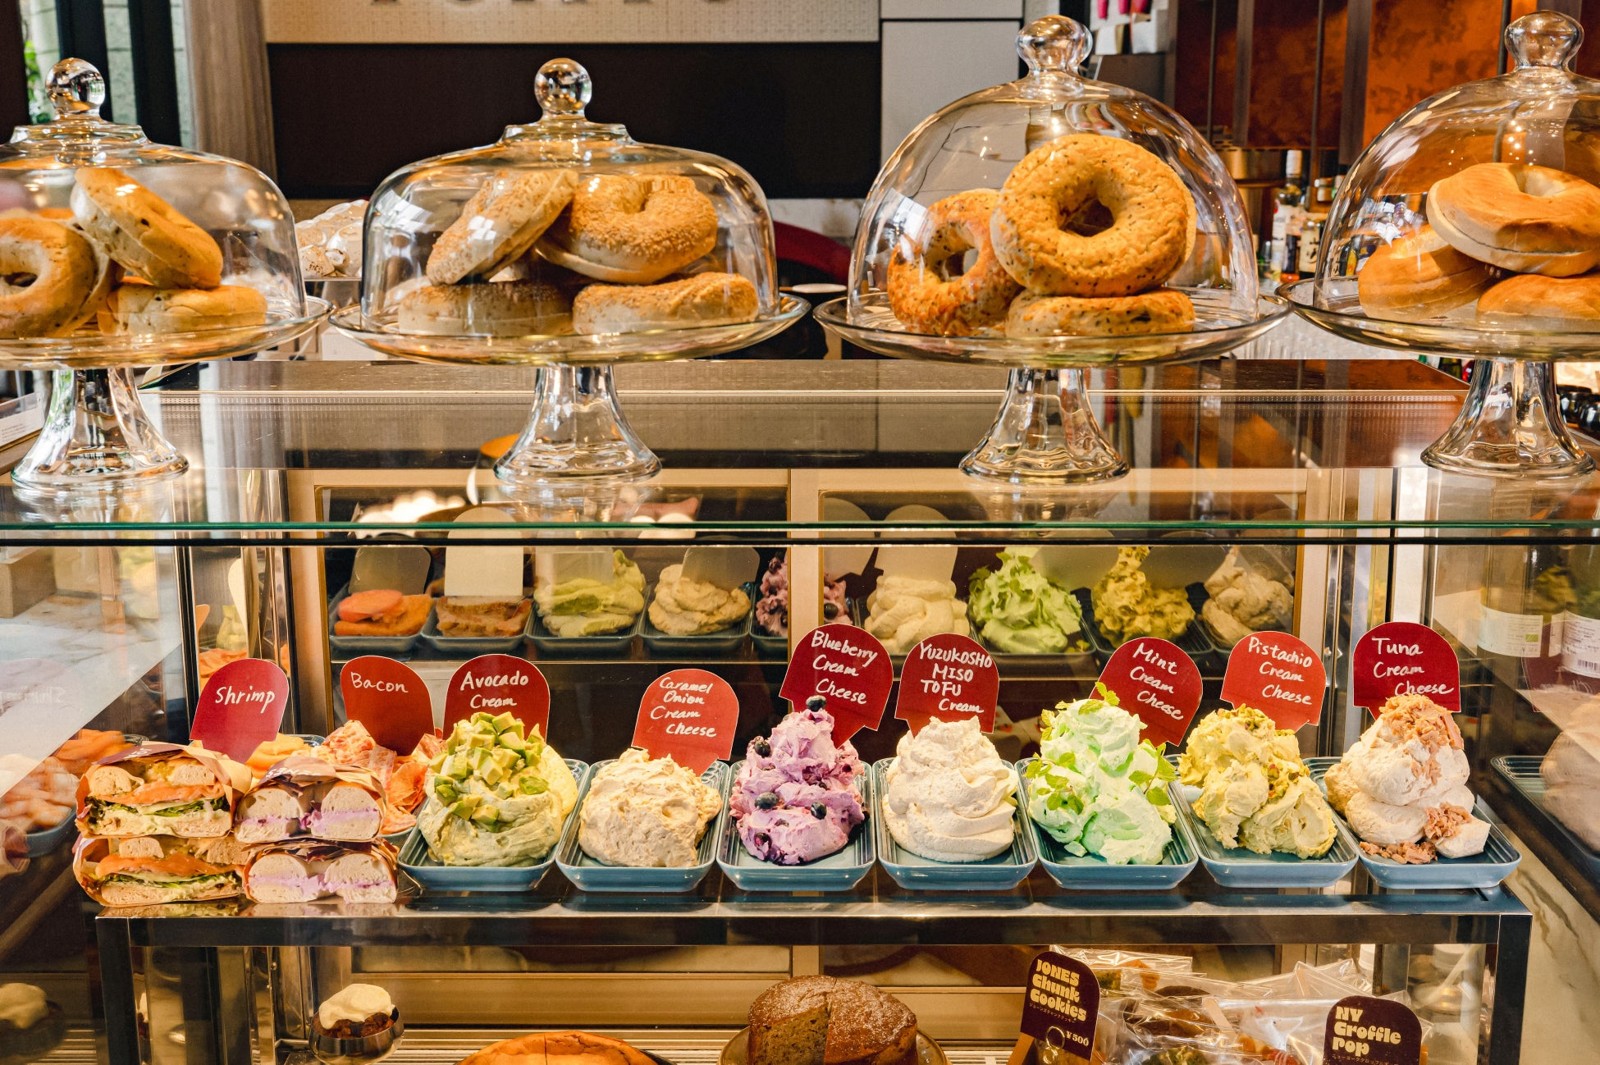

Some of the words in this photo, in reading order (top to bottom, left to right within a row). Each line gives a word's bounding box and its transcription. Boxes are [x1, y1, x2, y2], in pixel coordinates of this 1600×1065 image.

[811, 630, 878, 668] Blueberry
[1248, 636, 1313, 668] Pistachio
[1371, 637, 1424, 656] Tuna
[812, 654, 859, 677] Cream
[1132, 642, 1178, 675] Mint
[932, 662, 974, 682] MISO
[1129, 666, 1174, 694] Cream
[1259, 661, 1305, 682] Cream
[1373, 661, 1425, 678] Cream
[351, 672, 409, 694] Bacon
[460, 671, 529, 691] Avocado
[659, 676, 714, 694] Caramel
[815, 678, 867, 705] Cheese
[920, 679, 962, 696] TOFU
[1394, 680, 1455, 697] Cheese
[214, 685, 276, 714] Shrimp
[470, 694, 518, 709] Cream
[663, 690, 705, 705] Onion
[1137, 690, 1184, 720] Cheese
[1262, 684, 1313, 705] Cheese
[650, 705, 701, 720] Cream
[938, 698, 984, 713] Cream
[1036, 959, 1080, 987] JONES
[1032, 973, 1080, 1003] Chunk
[1030, 988, 1087, 1022] Cookies
[1335, 1006, 1364, 1023] NY
[1333, 1021, 1402, 1045] Croffle
